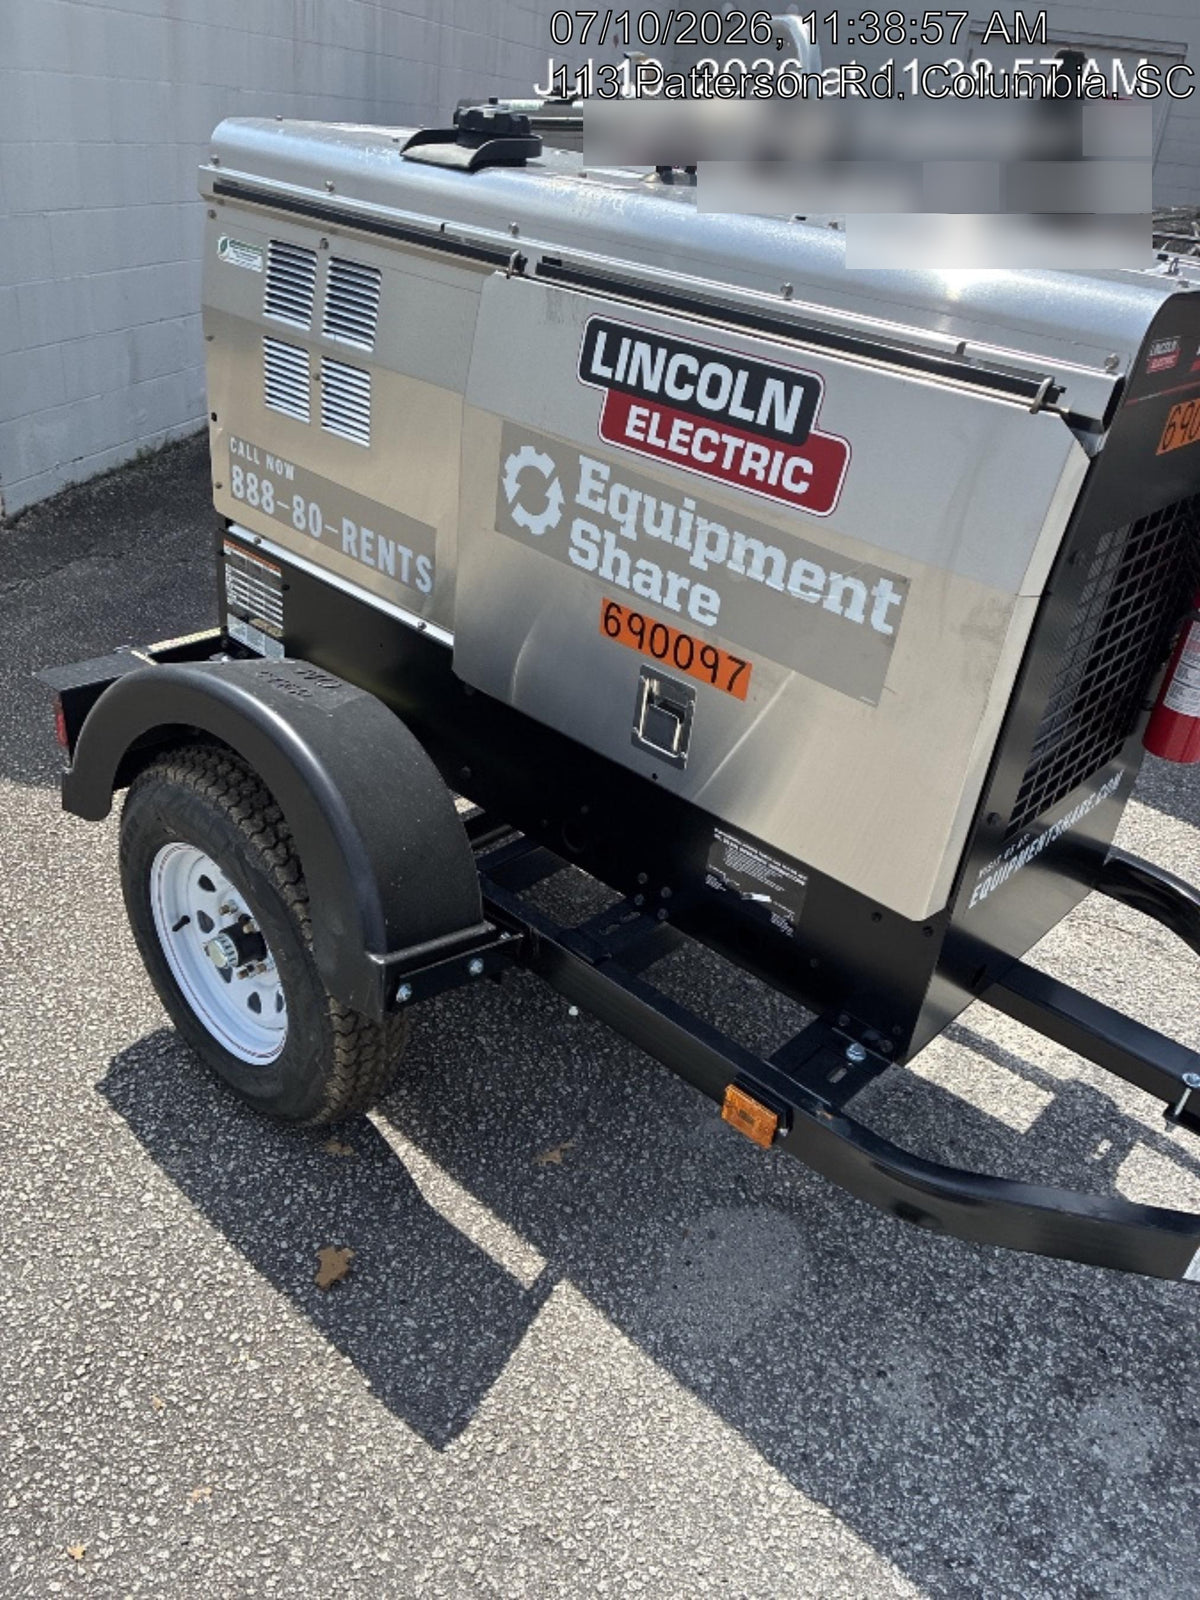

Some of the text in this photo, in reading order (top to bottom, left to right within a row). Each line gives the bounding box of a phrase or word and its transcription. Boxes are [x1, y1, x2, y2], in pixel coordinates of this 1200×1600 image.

[590, 330, 804, 434] LINCOLN
[230, 437, 295, 481] CALL NOW
[625, 405, 814, 495] ELECTRIC
[231, 465, 433, 593] 888-80-RENTS
[568, 518, 721, 627] Share
[575, 455, 903, 635] Equipment
[603, 602, 748, 693] 690097
